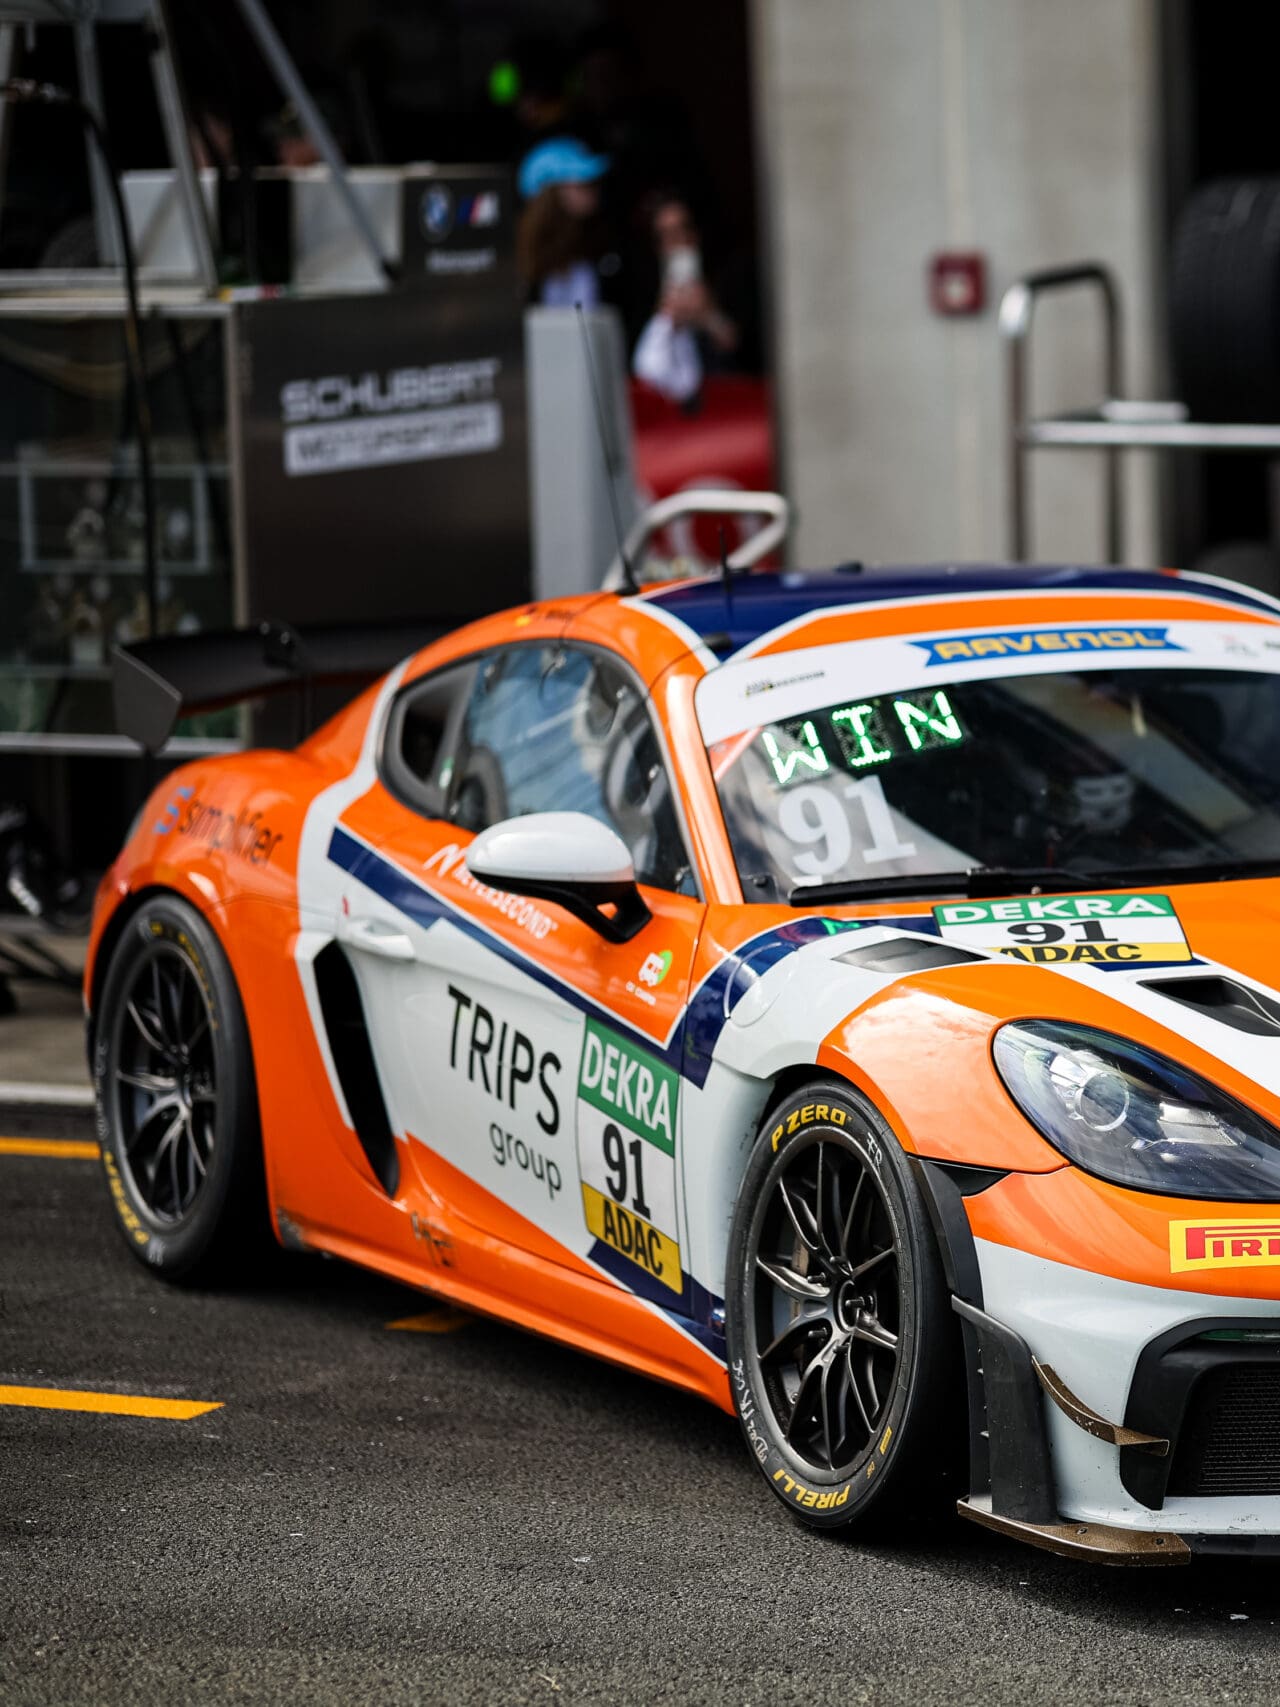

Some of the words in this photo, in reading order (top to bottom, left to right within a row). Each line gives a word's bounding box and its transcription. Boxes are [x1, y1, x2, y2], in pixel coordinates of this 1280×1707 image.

[933, 629, 1165, 660] RAVENOL
[762, 691, 963, 784] WIN
[778, 774, 917, 876] 91
[942, 897, 1167, 923] DEKRA
[1007, 920, 1118, 945] 91
[447, 984, 563, 1137] TRIPS
[580, 1030, 673, 1142] DEKRA
[489, 1121, 562, 1201] group
[770, 1124, 784, 1152] P
[786, 1104, 847, 1135] ZERO
[602, 1123, 652, 1222] 91
[604, 1198, 663, 1276] ADAC
[773, 1468, 852, 1509] PIRELLI
